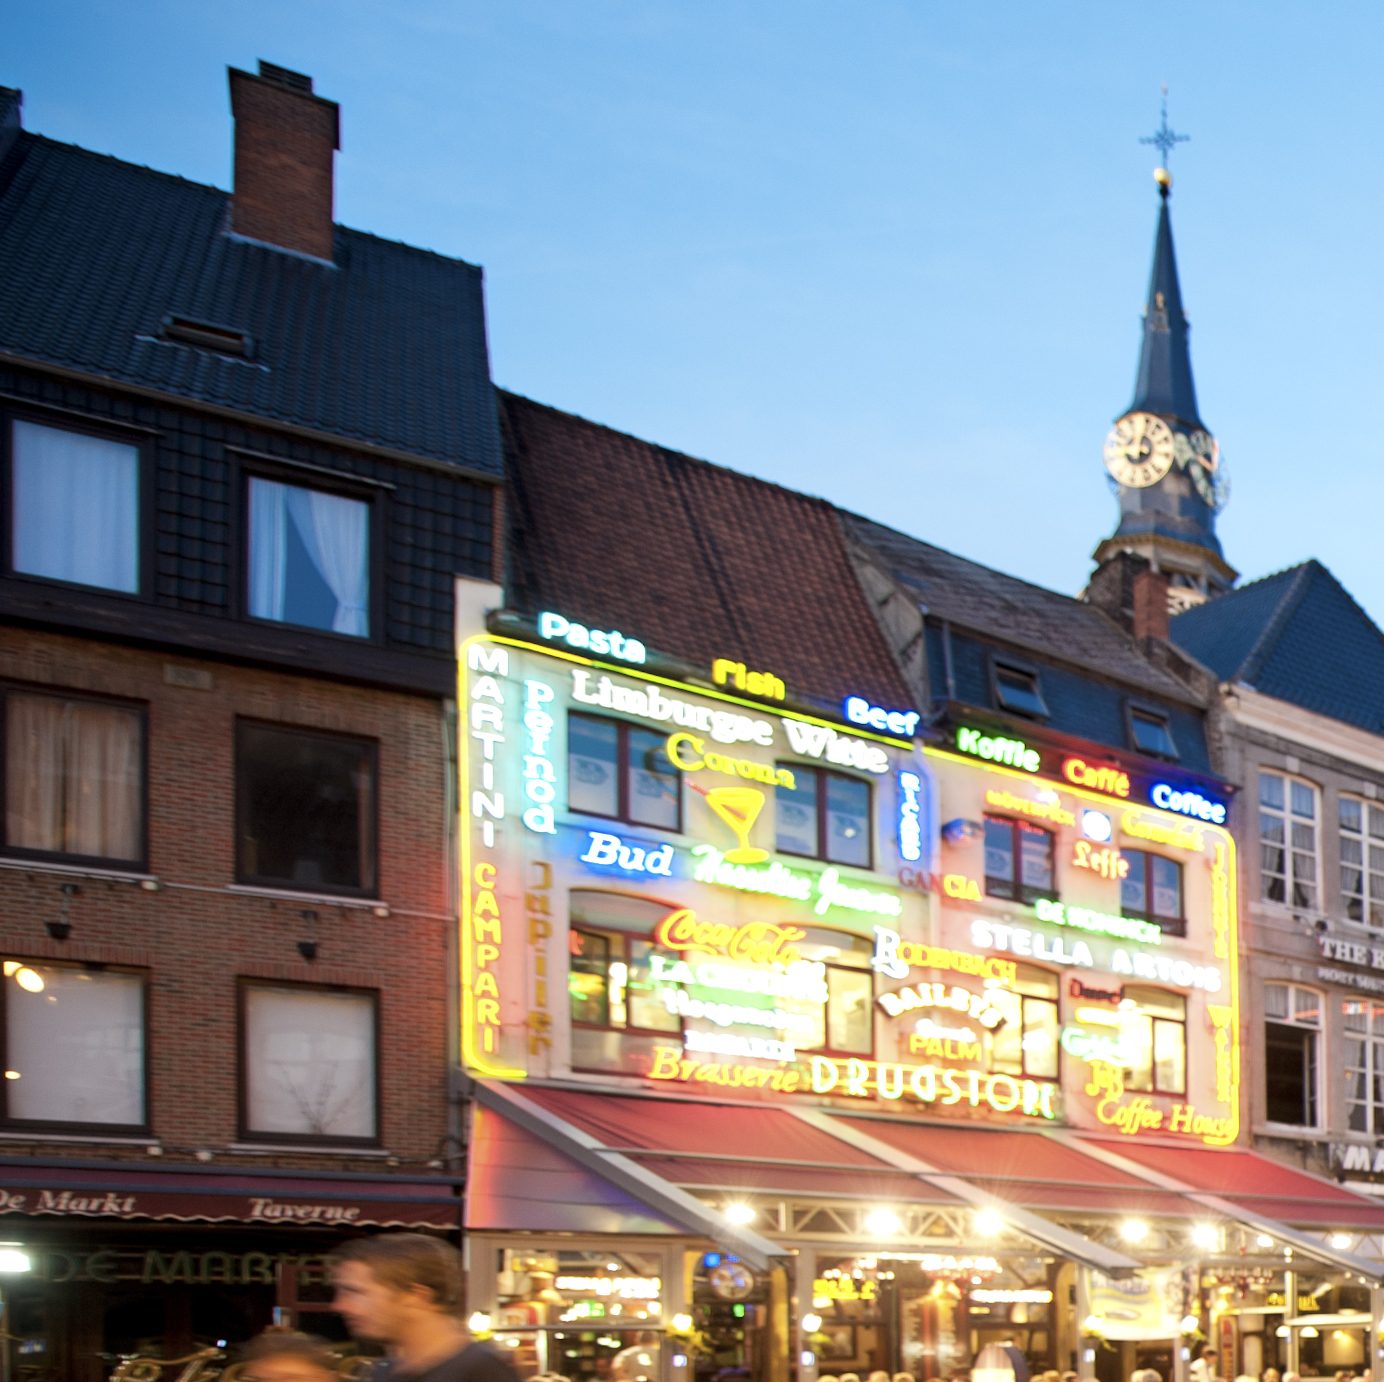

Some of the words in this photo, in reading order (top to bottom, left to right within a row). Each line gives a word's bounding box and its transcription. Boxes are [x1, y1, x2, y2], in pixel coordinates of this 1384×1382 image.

[538, 611, 646, 664] Pasta
[712, 658, 786, 700] Fish
[571, 668, 774, 746] Limburgse
[846, 696, 920, 736] Beef
[468, 643, 509, 848] MARTINI
[523, 679, 557, 835] Pernod
[666, 731, 798, 791] Corona
[957, 727, 1041, 772] Koffie
[1151, 784, 1227, 825] Coffee
[580, 830, 676, 877] Bud
[1071, 839, 1131, 880] Leffe
[899, 866, 983, 903] GANCIA
[473, 862, 502, 1053] CAMPARI
[971, 919, 1093, 967] STELLA
[1111, 948, 1222, 993] ARTOIS
[1319, 936, 1367, 965] THE
[647, 1044, 801, 1093] Brasserie
[910, 1032, 982, 1062] PALM
[810, 1055, 1056, 1120] DRUGSTORE
[1097, 1098, 1163, 1135] Coffee
[1170, 1103, 1233, 1138] House
[37, 1189, 137, 1214] Markt
[250, 1197, 361, 1221] Taverne
